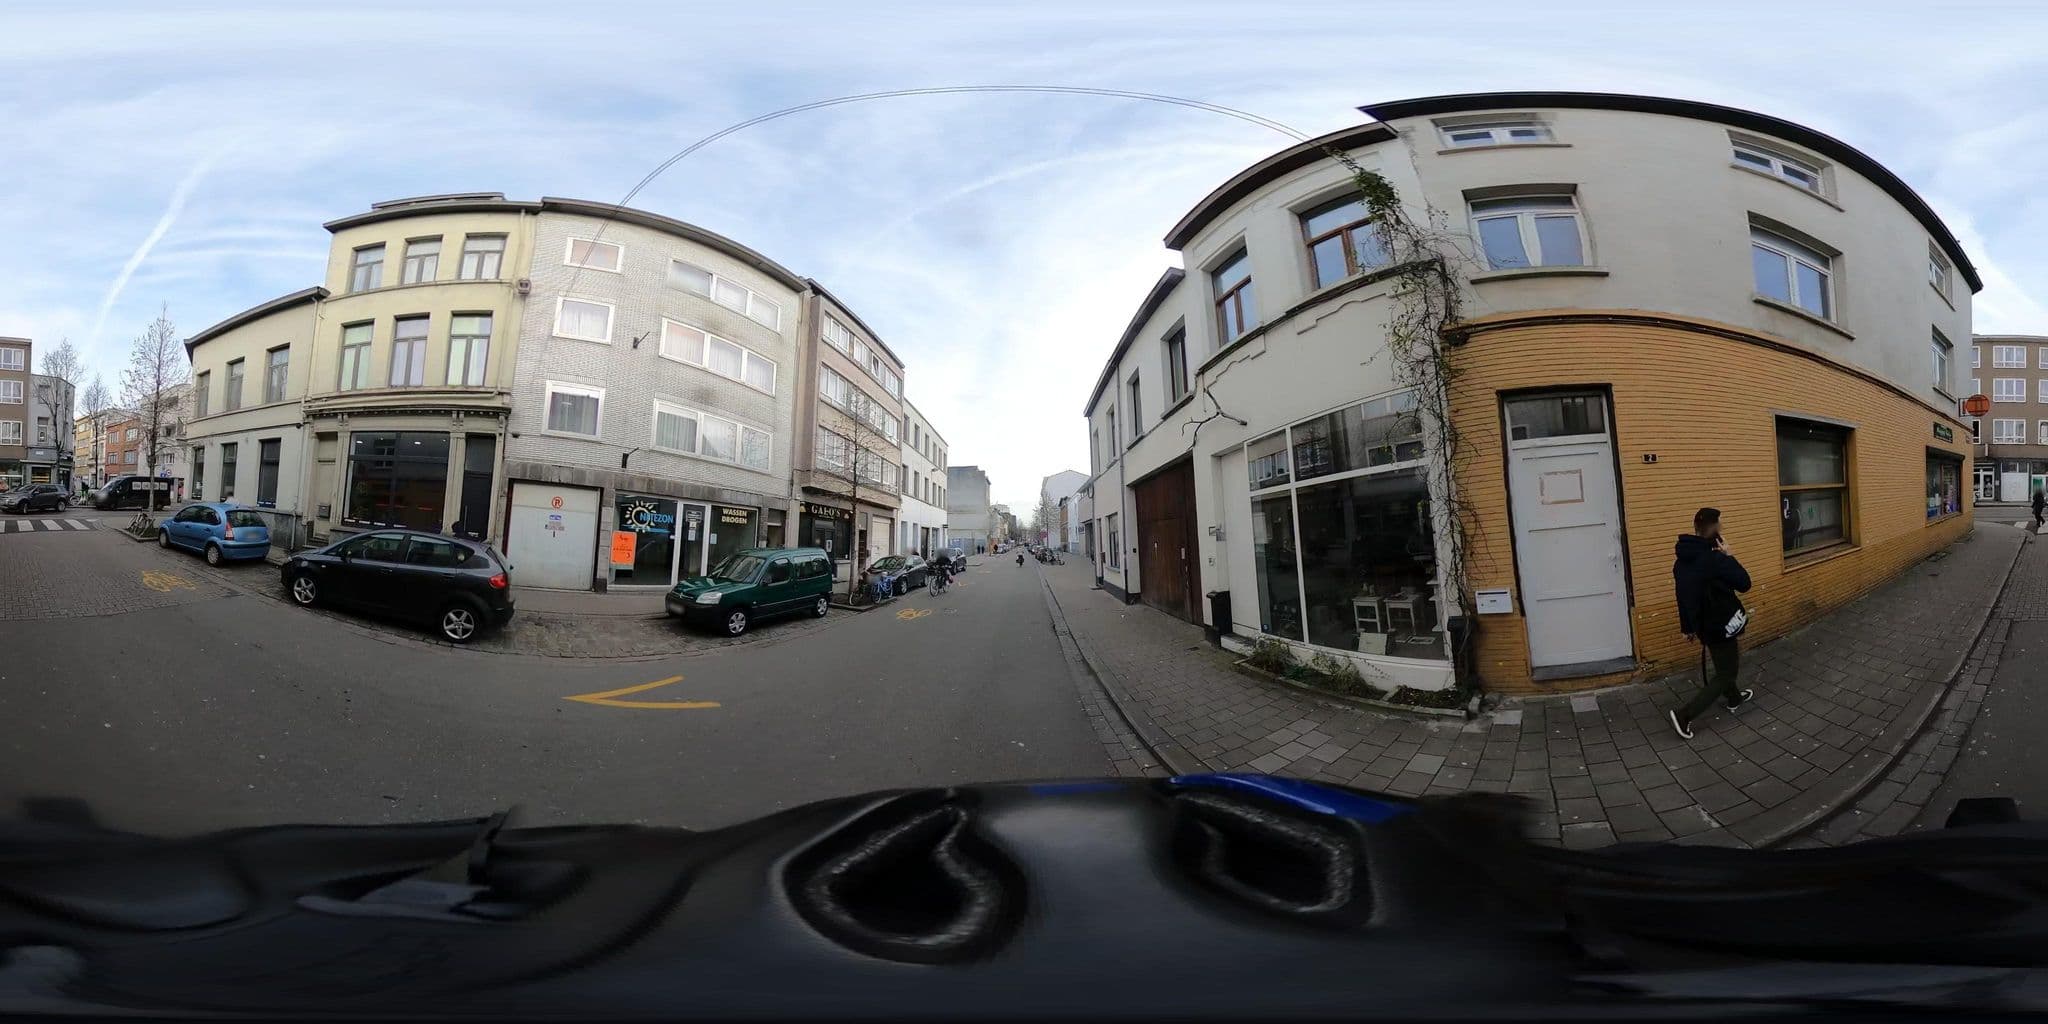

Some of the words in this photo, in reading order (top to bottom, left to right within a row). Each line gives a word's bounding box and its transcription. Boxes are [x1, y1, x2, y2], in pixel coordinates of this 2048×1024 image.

[722, 508, 747, 517] WASSEN
[721, 515, 747, 524] DROGEN
[1725, 609, 1744, 634] NIKE
